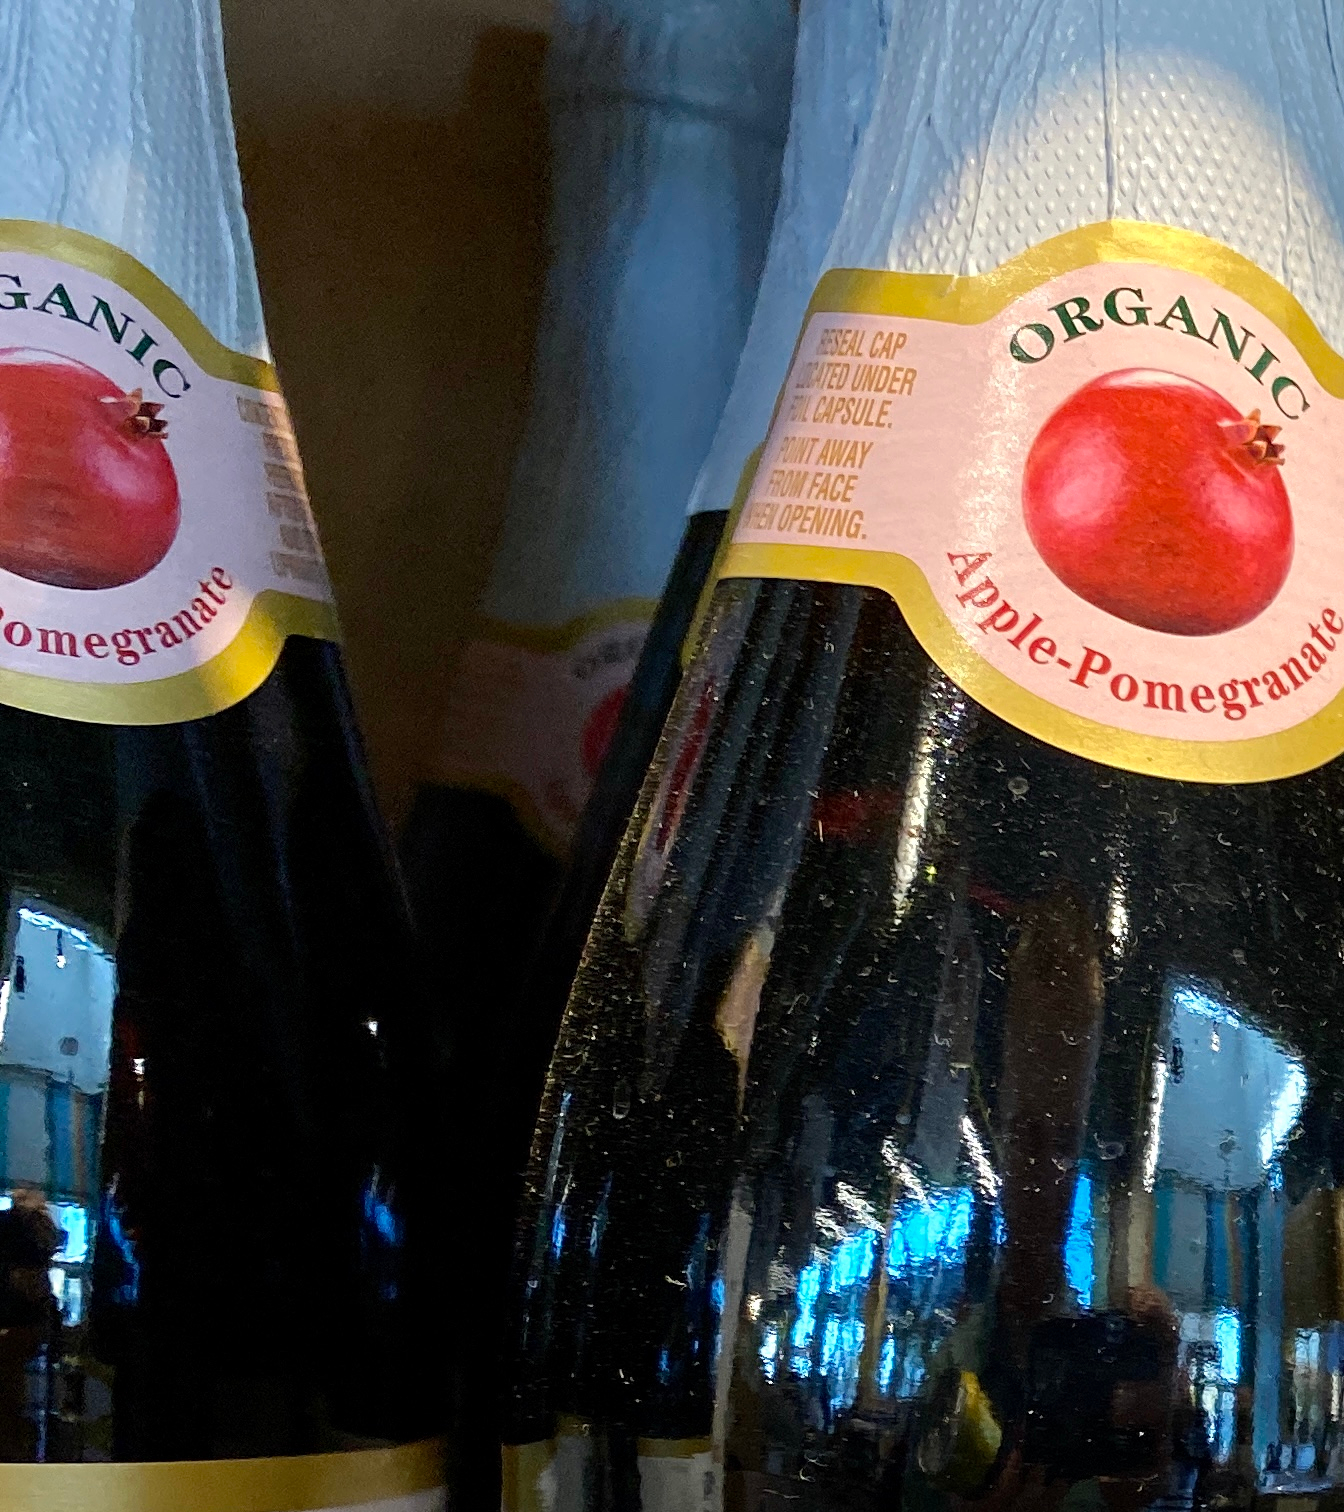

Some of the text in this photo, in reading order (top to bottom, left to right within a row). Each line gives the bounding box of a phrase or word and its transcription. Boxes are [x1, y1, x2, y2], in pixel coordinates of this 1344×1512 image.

[0, 273, 192, 399] GANIC
[869, 331, 907, 360] CAP
[1008, 286, 1310, 421] ORGANIC
[851, 364, 917, 395] UNDER
[812, 396, 893, 429] CAPSULE.
[817, 439, 874, 469] AWAY
[808, 472, 859, 503] FACE
[777, 504, 867, 540] OPENING.
[0, 564, 235, 666] omegranate
[947, 547, 1344, 721] Apple-Pomegranate
